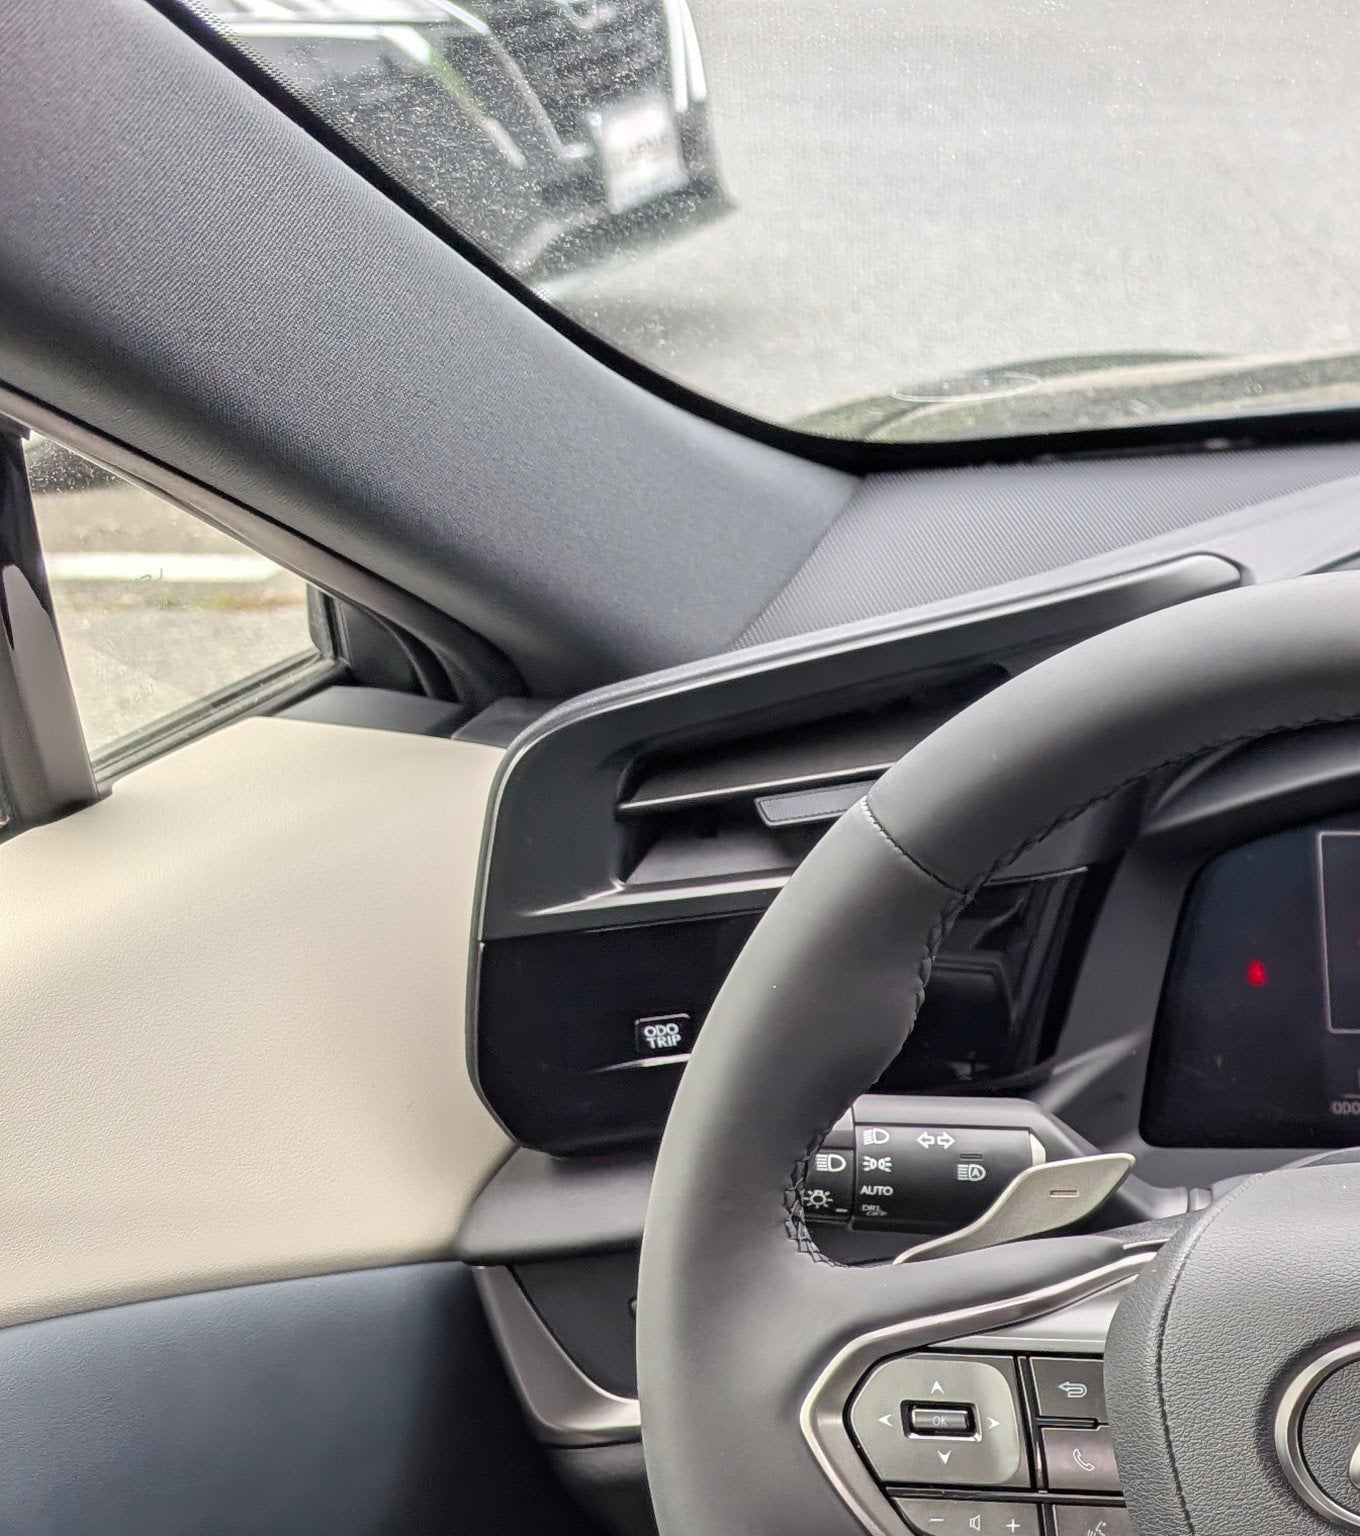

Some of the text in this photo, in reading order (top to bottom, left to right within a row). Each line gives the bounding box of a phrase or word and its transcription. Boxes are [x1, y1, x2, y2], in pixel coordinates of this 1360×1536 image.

[643, 1023, 679, 1037] ODO
[646, 1034, 681, 1049] TRIP
[860, 1185, 894, 1196] AUTO
[932, 1415, 948, 1428] OK
